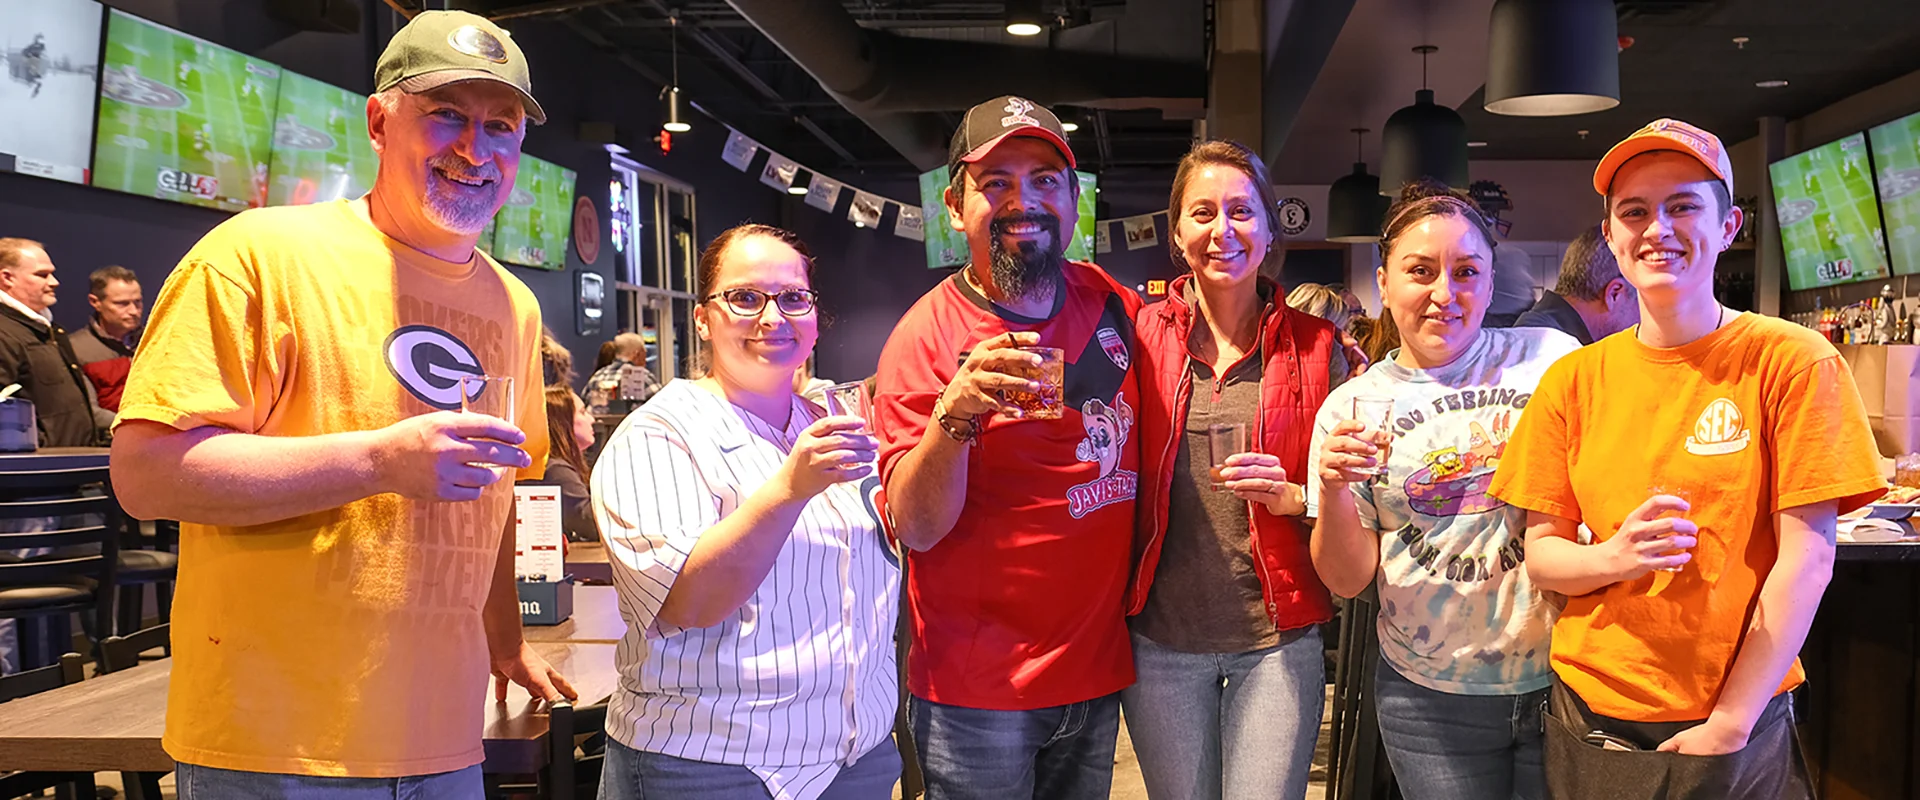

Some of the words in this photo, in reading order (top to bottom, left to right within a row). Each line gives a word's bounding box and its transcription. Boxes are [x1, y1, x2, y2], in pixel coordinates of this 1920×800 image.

[1147, 280, 1167, 295] EXIT
[383, 325, 488, 410] G
[1431, 387, 1533, 415] FEELING
[1698, 401, 1739, 442] SEC
